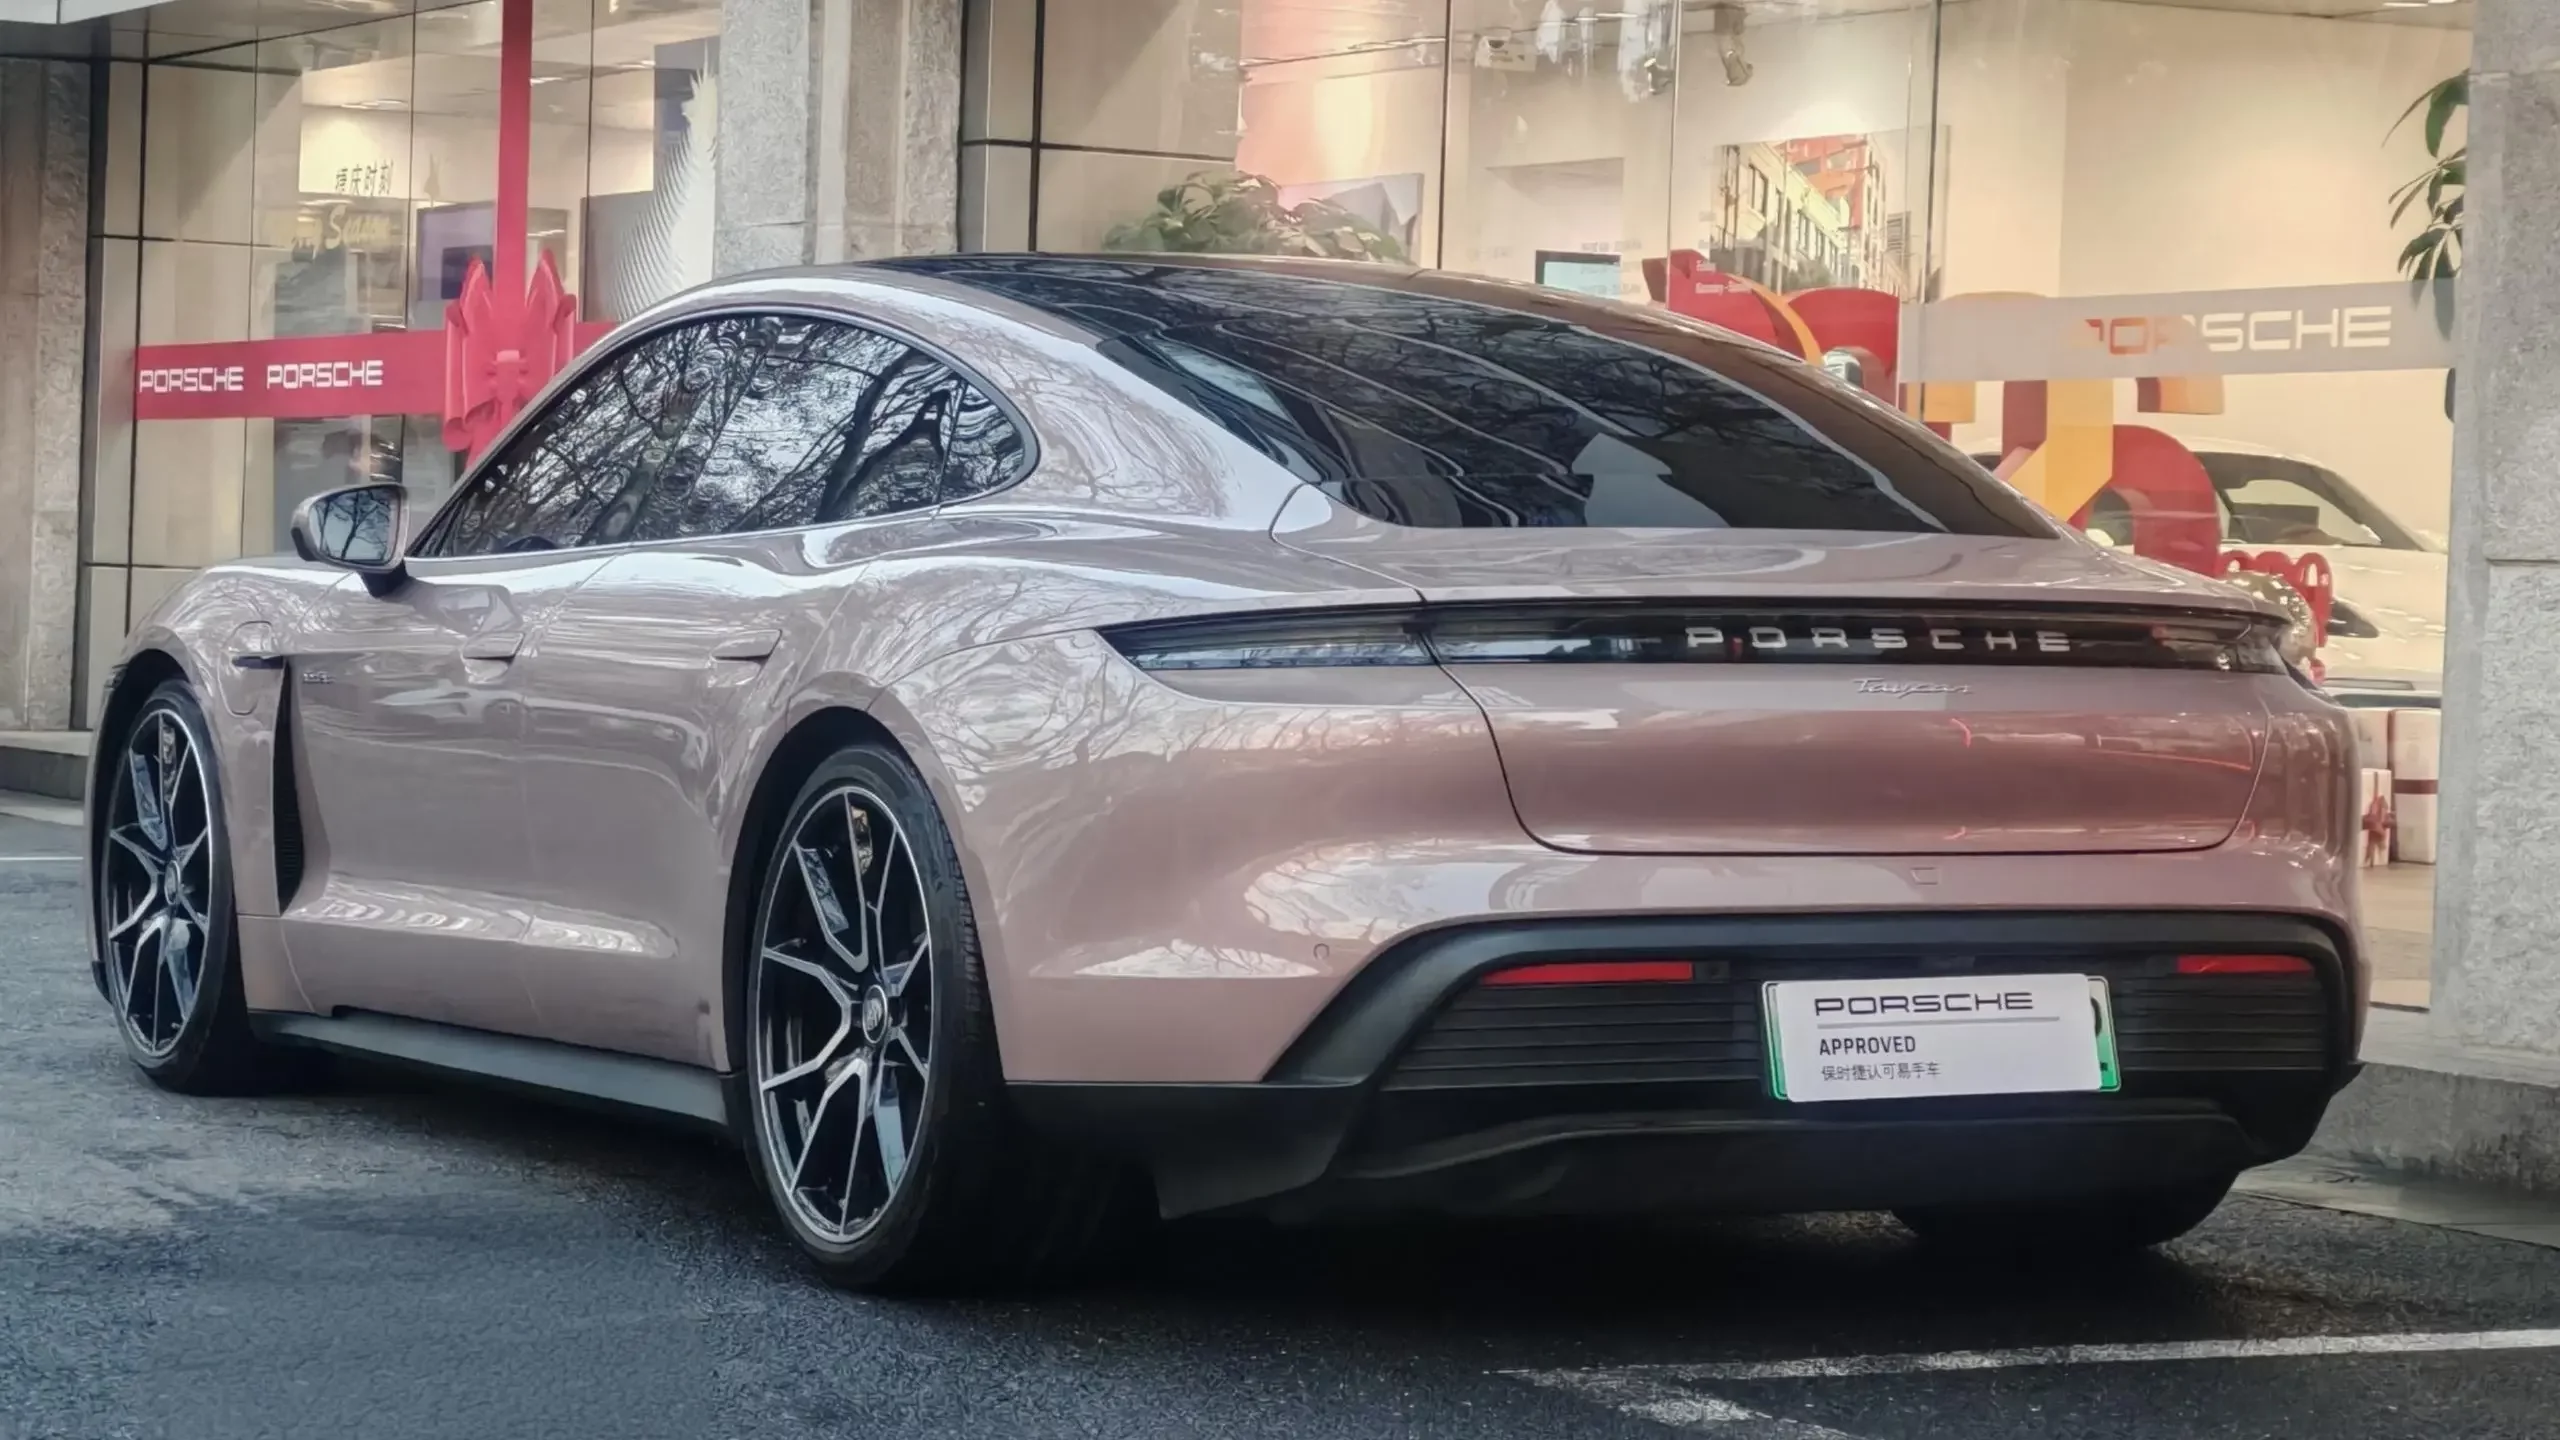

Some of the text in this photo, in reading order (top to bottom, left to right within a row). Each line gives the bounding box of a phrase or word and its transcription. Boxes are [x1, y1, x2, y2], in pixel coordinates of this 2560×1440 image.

[139, 360, 384, 393] PORSCHE PORSCHE
[1685, 627, 2071, 652] PORSCHE
[1850, 678, 1974, 699] Taycan
[1814, 992, 2033, 1016] PORSCHE
[1819, 1036, 1916, 1056] APPROVED
[1822, 1061, 1942, 1081] 保时捷认可易手车
